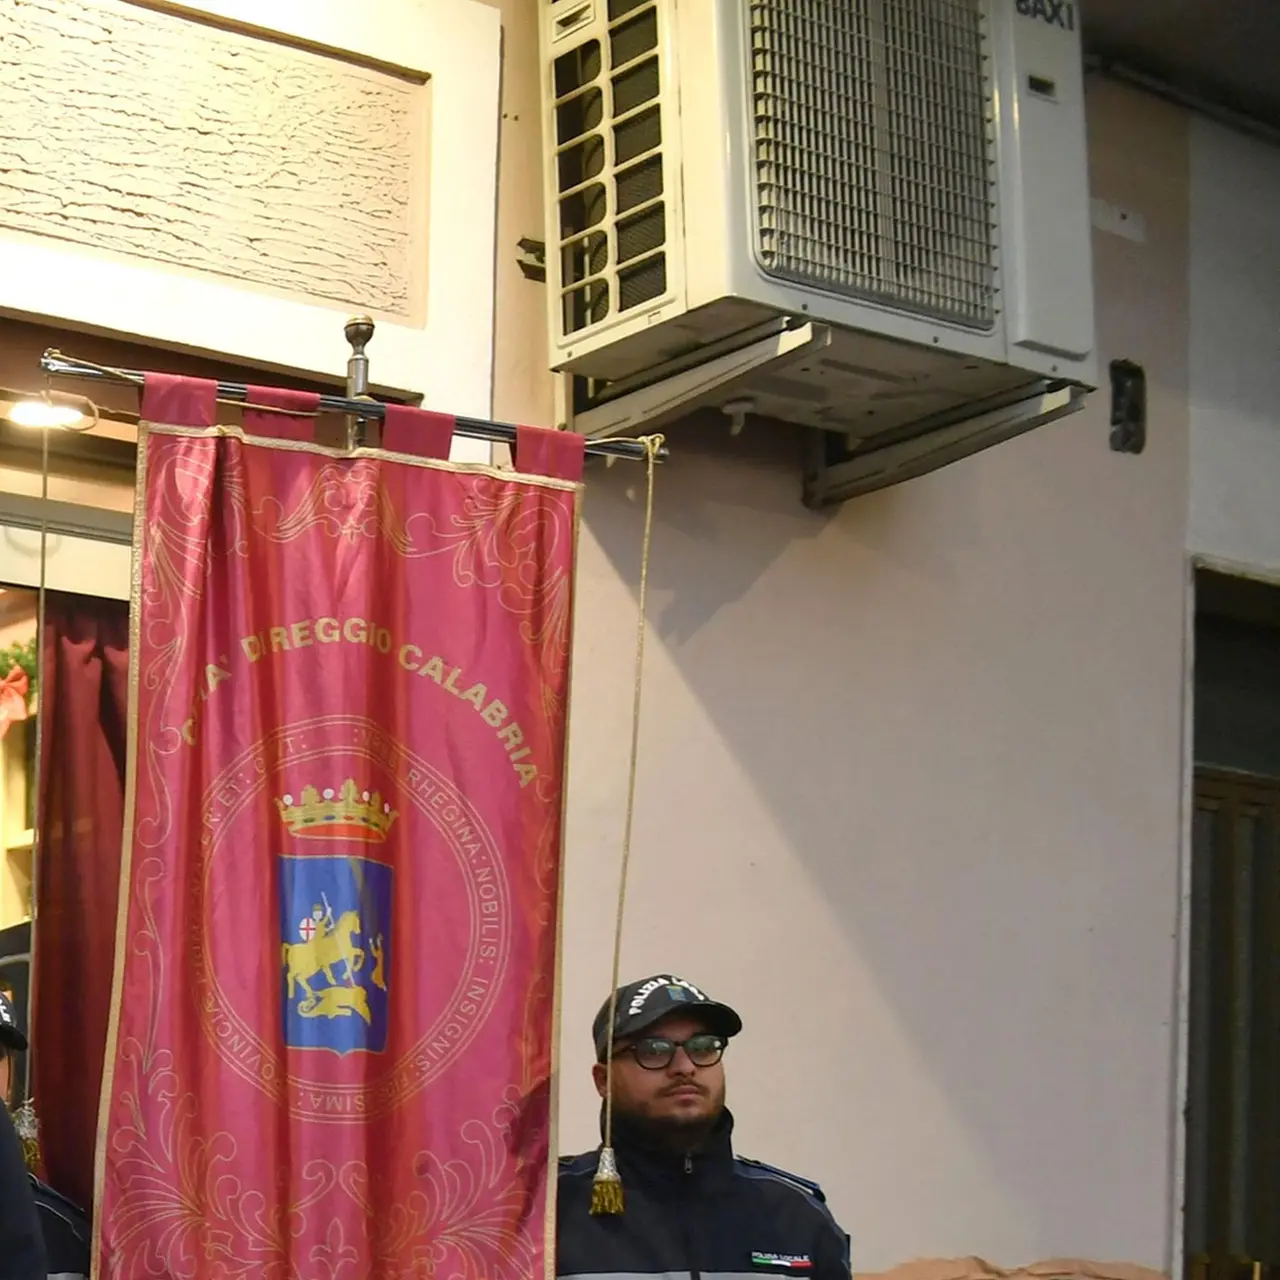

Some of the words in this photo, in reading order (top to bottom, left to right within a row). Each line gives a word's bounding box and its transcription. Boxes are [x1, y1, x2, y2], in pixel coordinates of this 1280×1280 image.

[269, 617, 391, 654] REGGIO
[398, 644, 540, 789] CALABRIA
[628, 977, 671, 1016] POLIZIA
